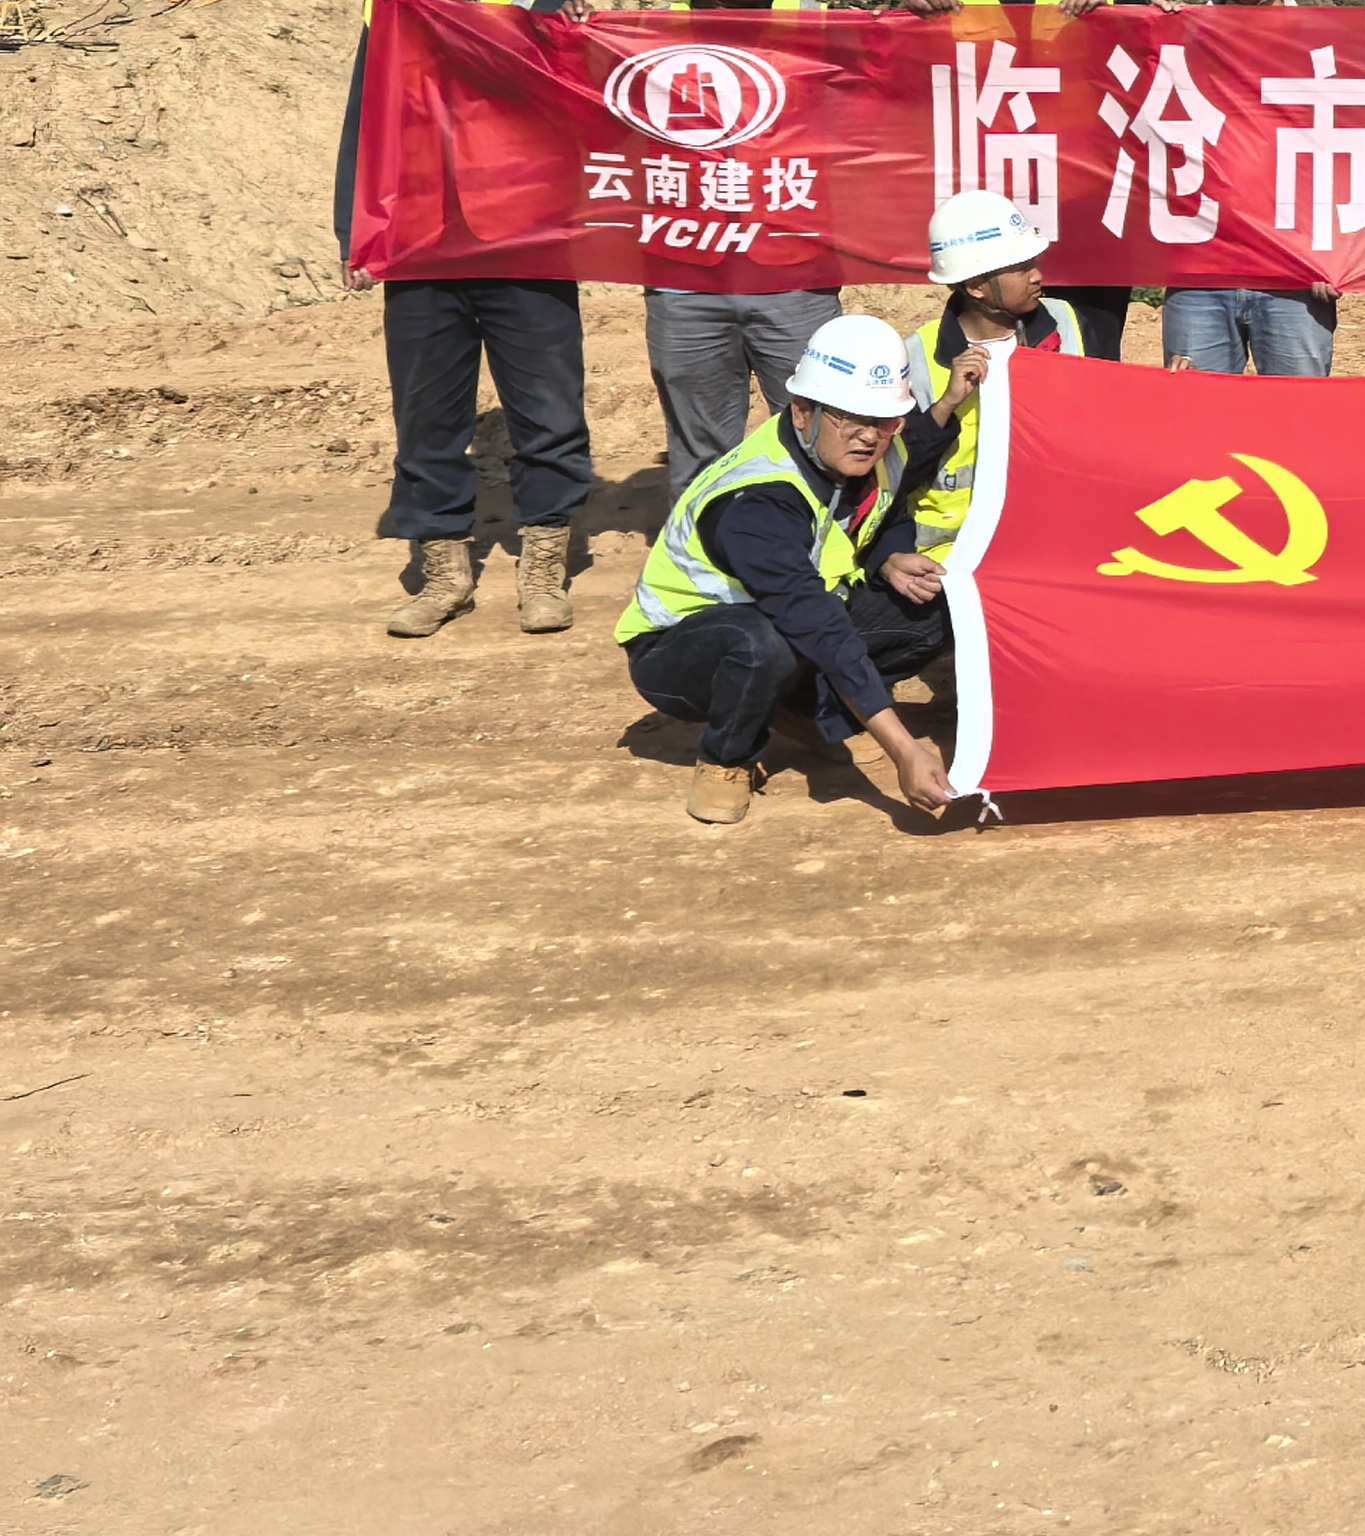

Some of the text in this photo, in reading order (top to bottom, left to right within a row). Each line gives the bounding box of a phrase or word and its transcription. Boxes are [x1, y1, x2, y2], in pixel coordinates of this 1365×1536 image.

[582, 150, 818, 213] 云南建投
[637, 213, 761, 253] YCIH
